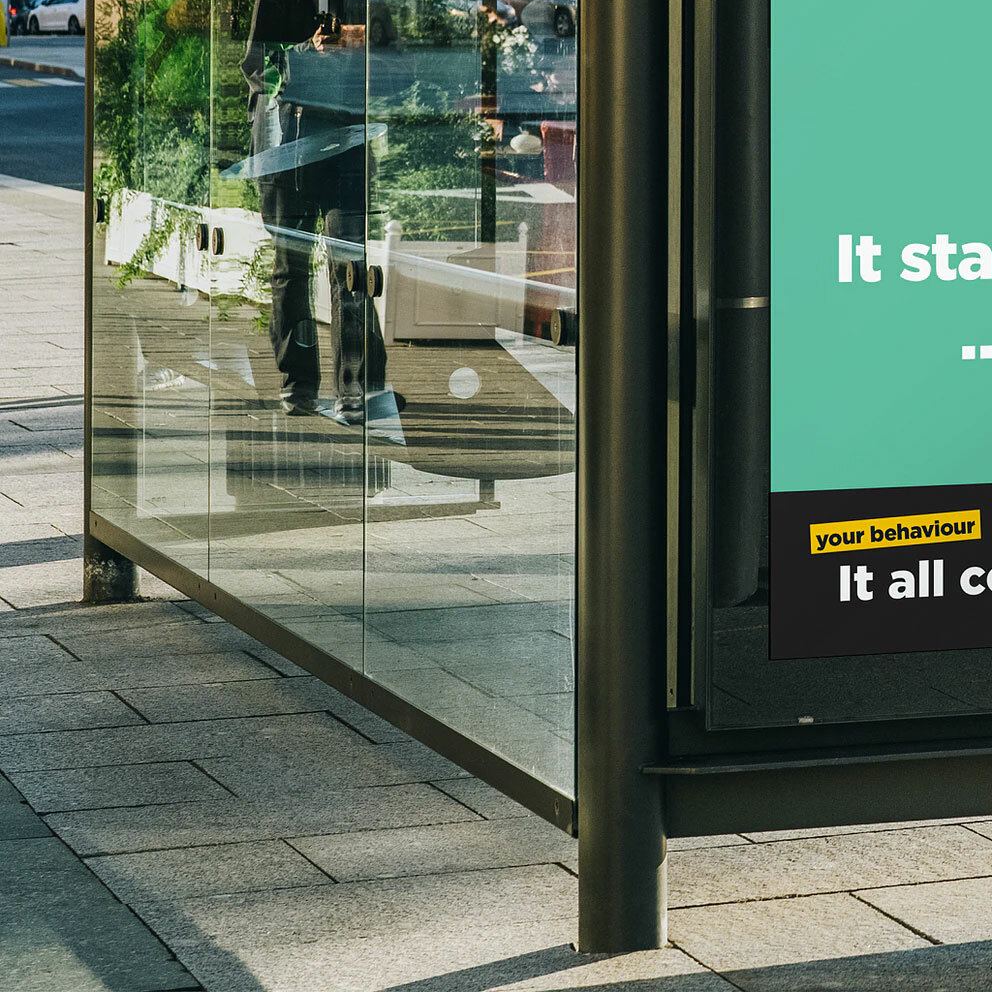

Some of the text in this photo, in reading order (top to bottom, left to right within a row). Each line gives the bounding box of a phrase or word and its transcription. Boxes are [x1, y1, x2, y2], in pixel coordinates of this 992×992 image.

[838, 234, 882, 283] It
[815, 520, 976, 551] your behaviour
[838, 565, 874, 602] It
[888, 559, 944, 600] all
